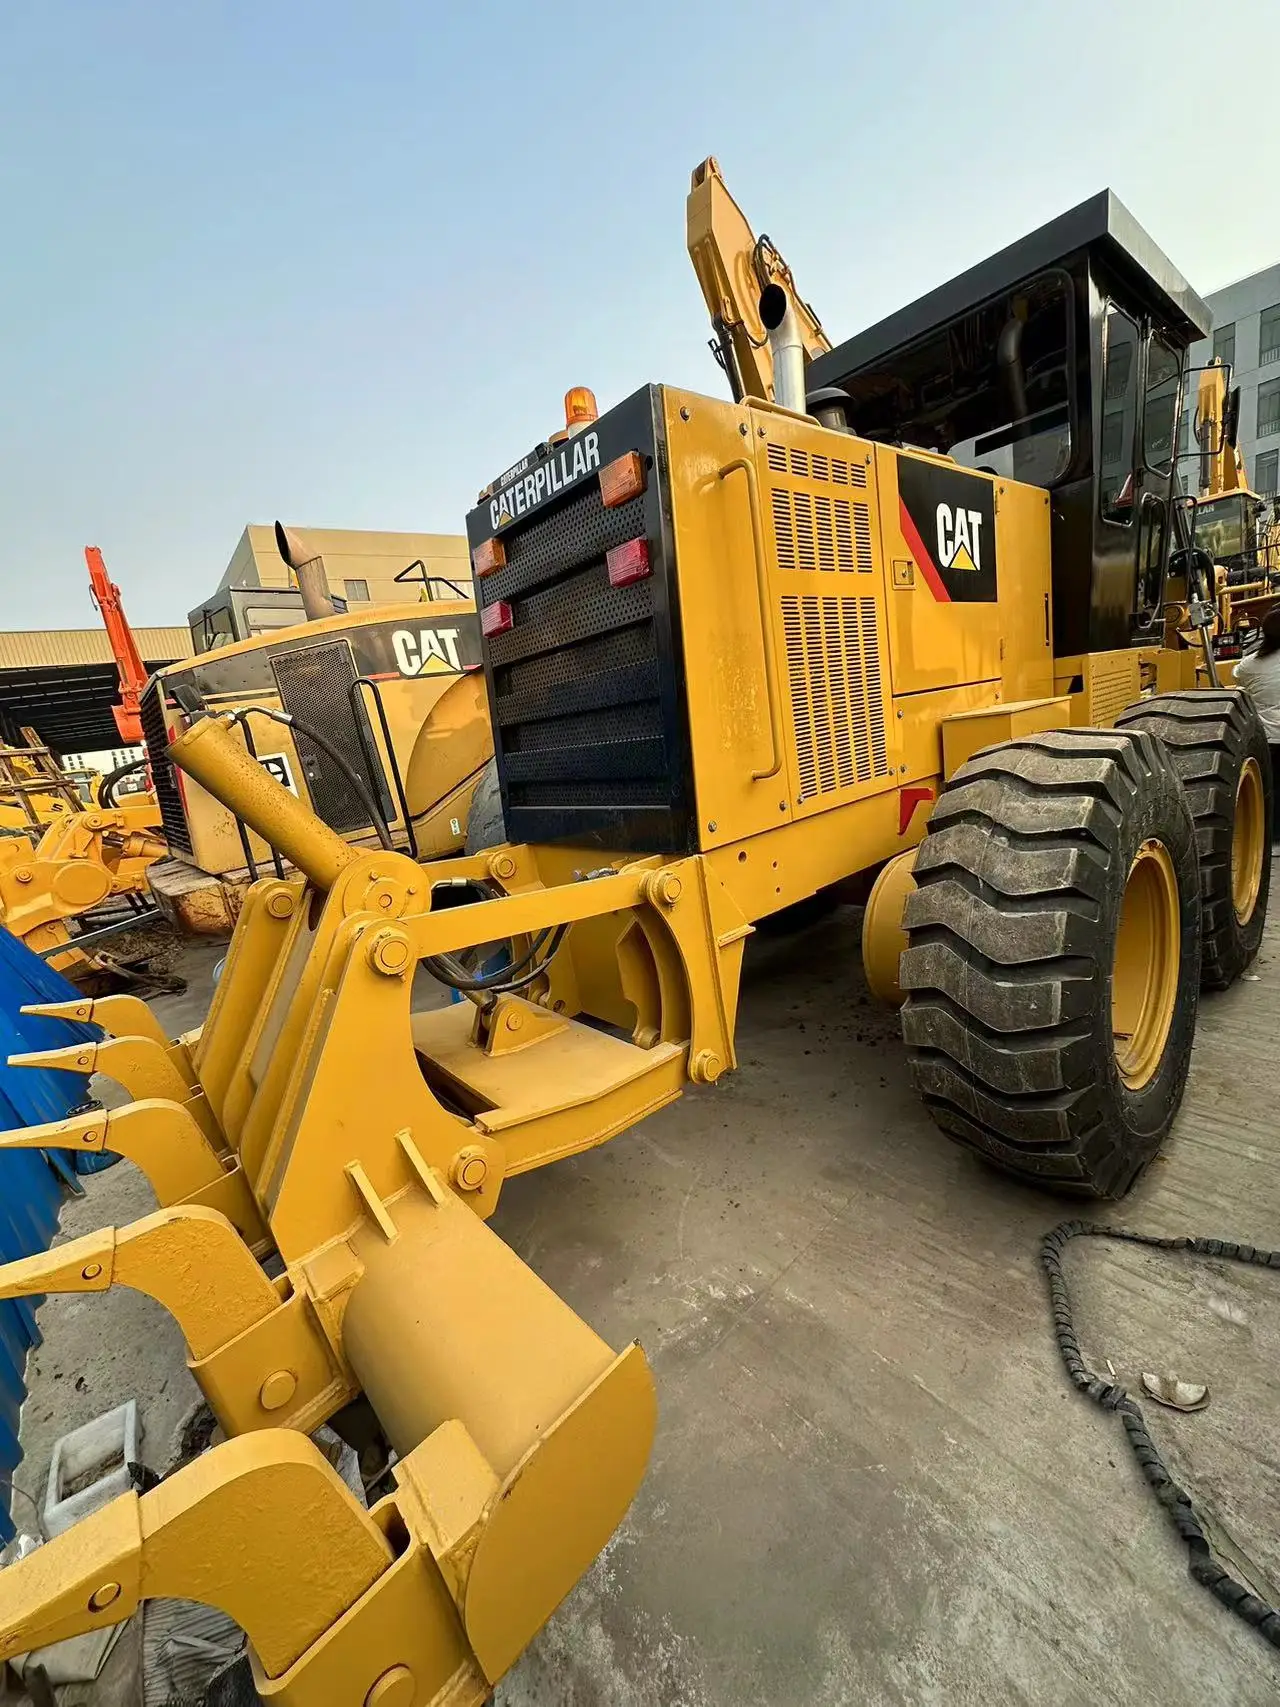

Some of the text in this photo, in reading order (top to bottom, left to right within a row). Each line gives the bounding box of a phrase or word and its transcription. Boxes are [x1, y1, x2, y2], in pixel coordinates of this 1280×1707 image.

[490, 432, 600, 530] CATERPILLAR
[936, 503, 982, 571] CAT
[391, 629, 462, 676] CAT
